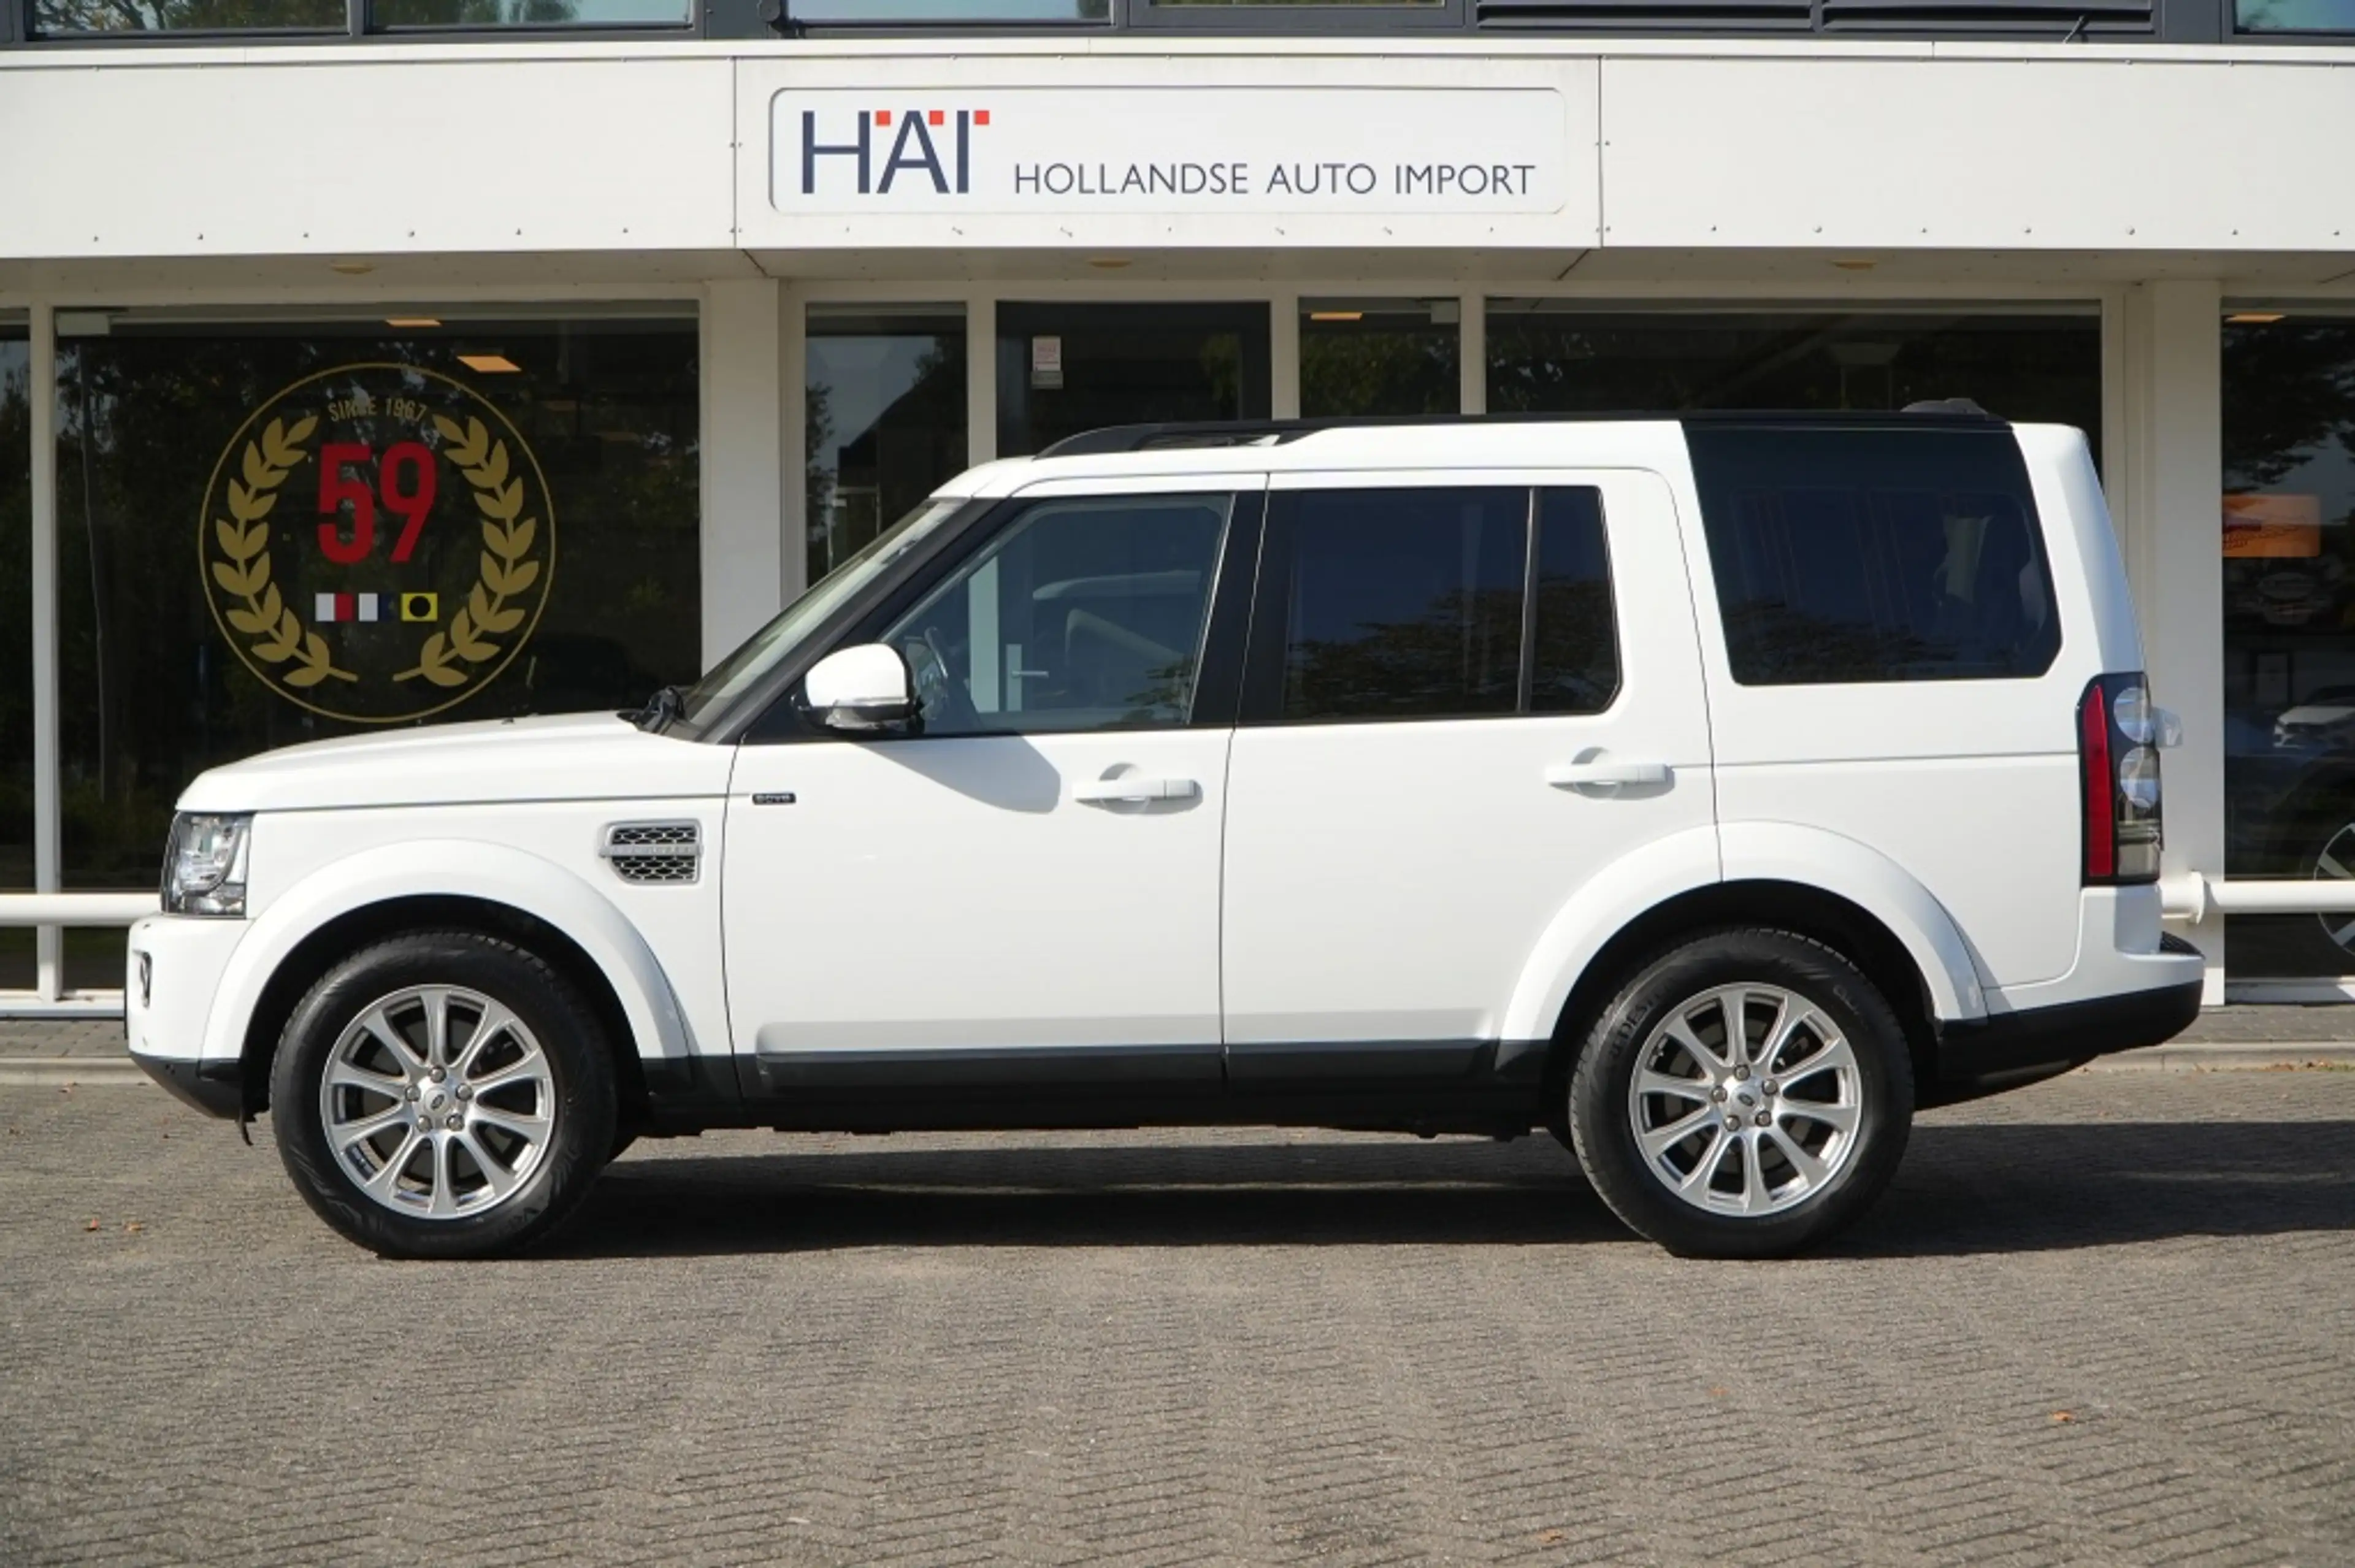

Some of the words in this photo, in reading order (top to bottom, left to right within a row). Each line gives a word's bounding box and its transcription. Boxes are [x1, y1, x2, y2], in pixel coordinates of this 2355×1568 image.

[1016, 163, 1247, 194] HOLLANDSE
[1266, 163, 1376, 194] AUTO
[1396, 164, 1535, 194] IMPORT
[385, 397, 427, 422] 1967
[317, 442, 437, 564] 59
